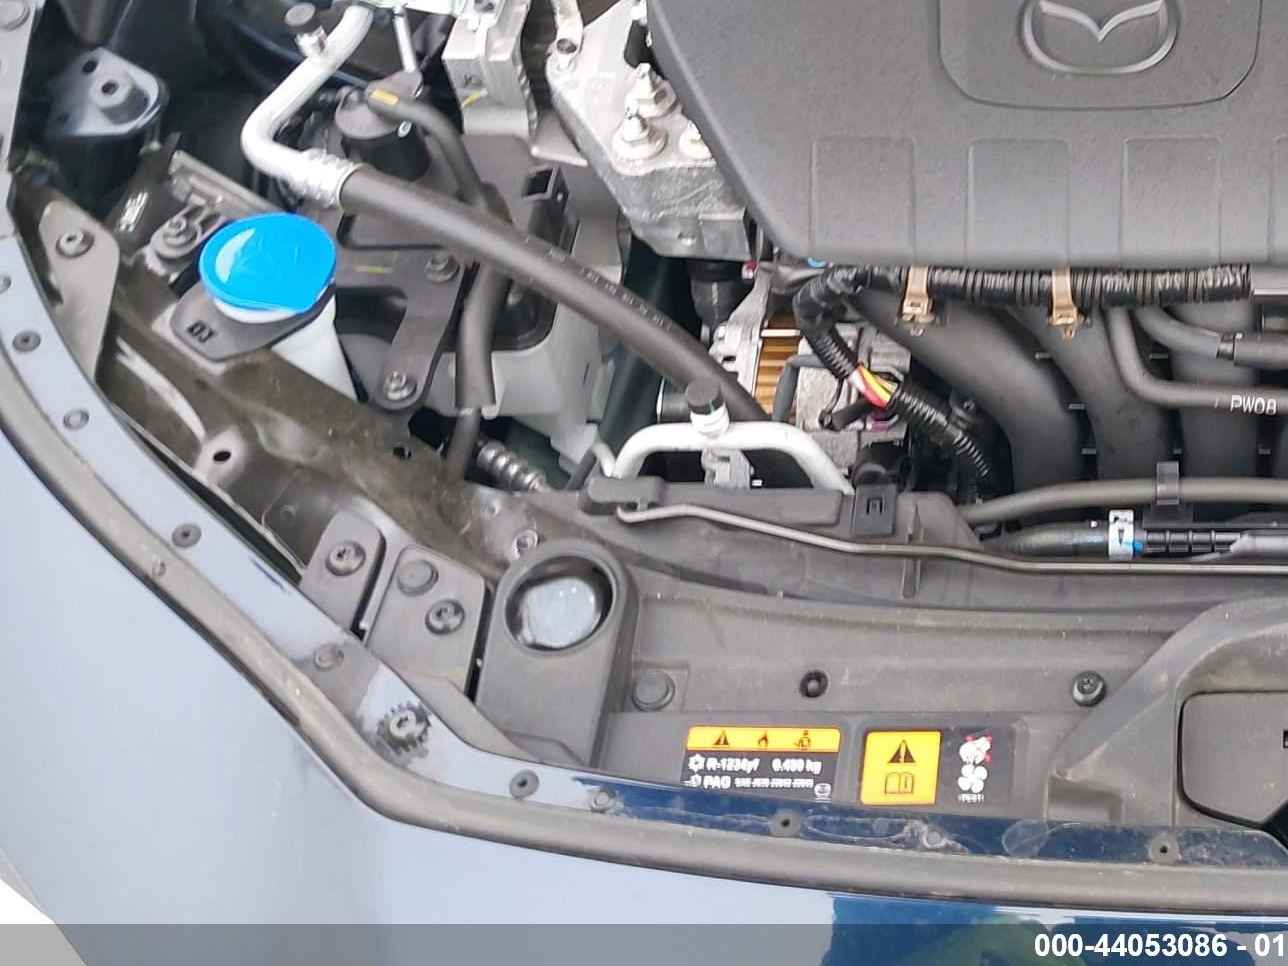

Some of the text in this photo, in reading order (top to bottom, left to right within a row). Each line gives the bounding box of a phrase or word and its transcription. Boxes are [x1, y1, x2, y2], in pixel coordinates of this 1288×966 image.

[1230, 394, 1277, 416] PW08
[706, 757, 760, 774] R-1234yf
[805, 758, 822, 775] kg
[703, 775, 731, 789] PAG
